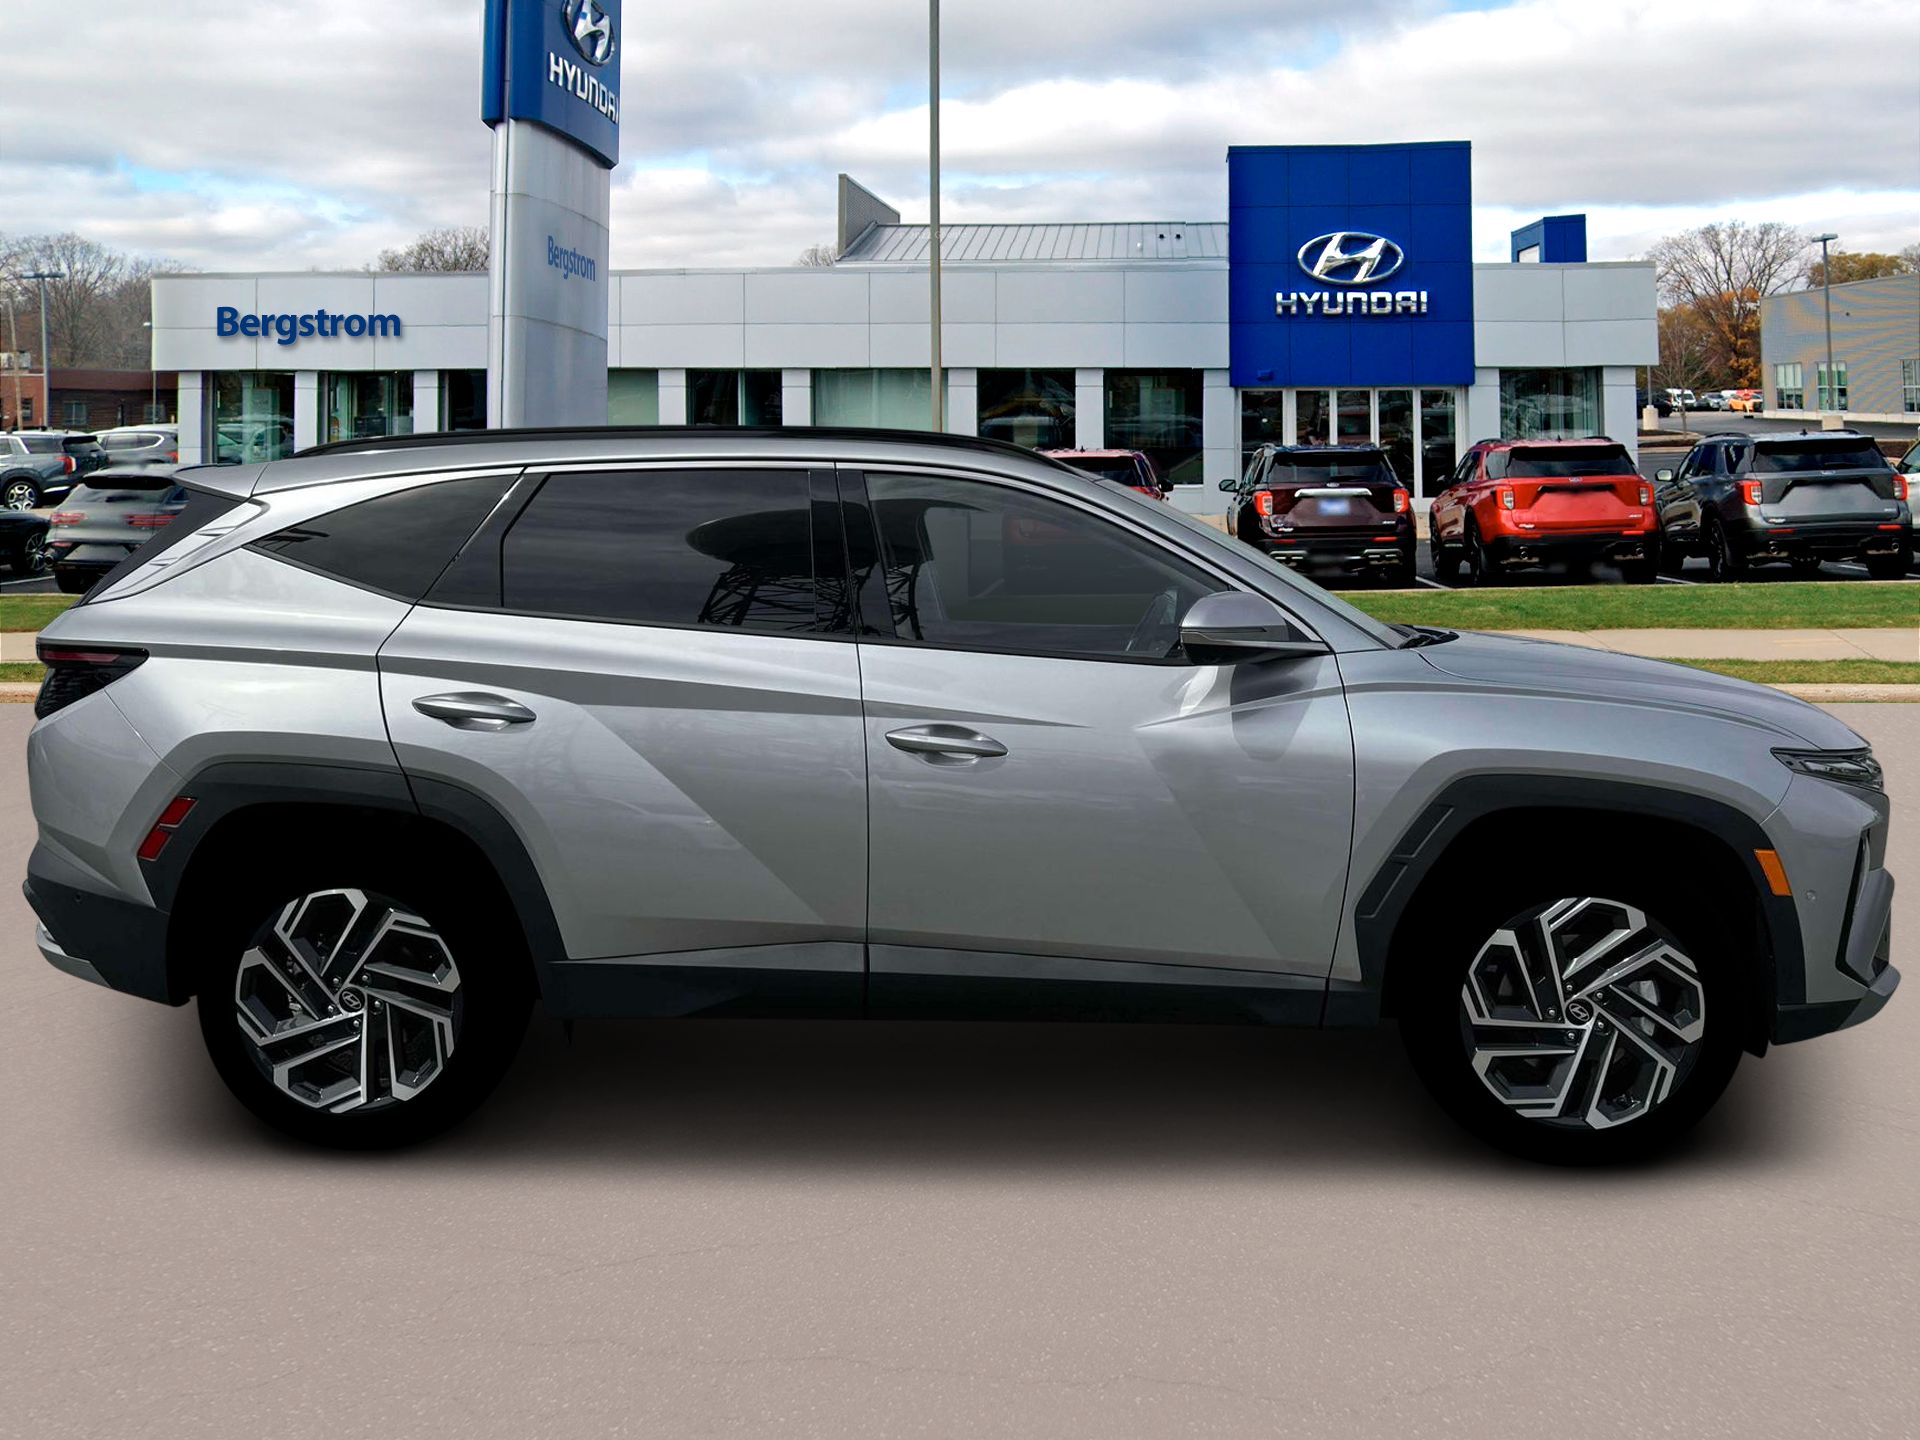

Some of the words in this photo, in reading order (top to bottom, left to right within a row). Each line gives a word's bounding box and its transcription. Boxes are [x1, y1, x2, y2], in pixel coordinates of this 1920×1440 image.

[549, 52, 619, 124] HYUNDAI
[547, 235, 596, 281] Bergstrom
[1275, 290, 1428, 316] HYUNDAI
[216, 306, 401, 346] Bergstrom
